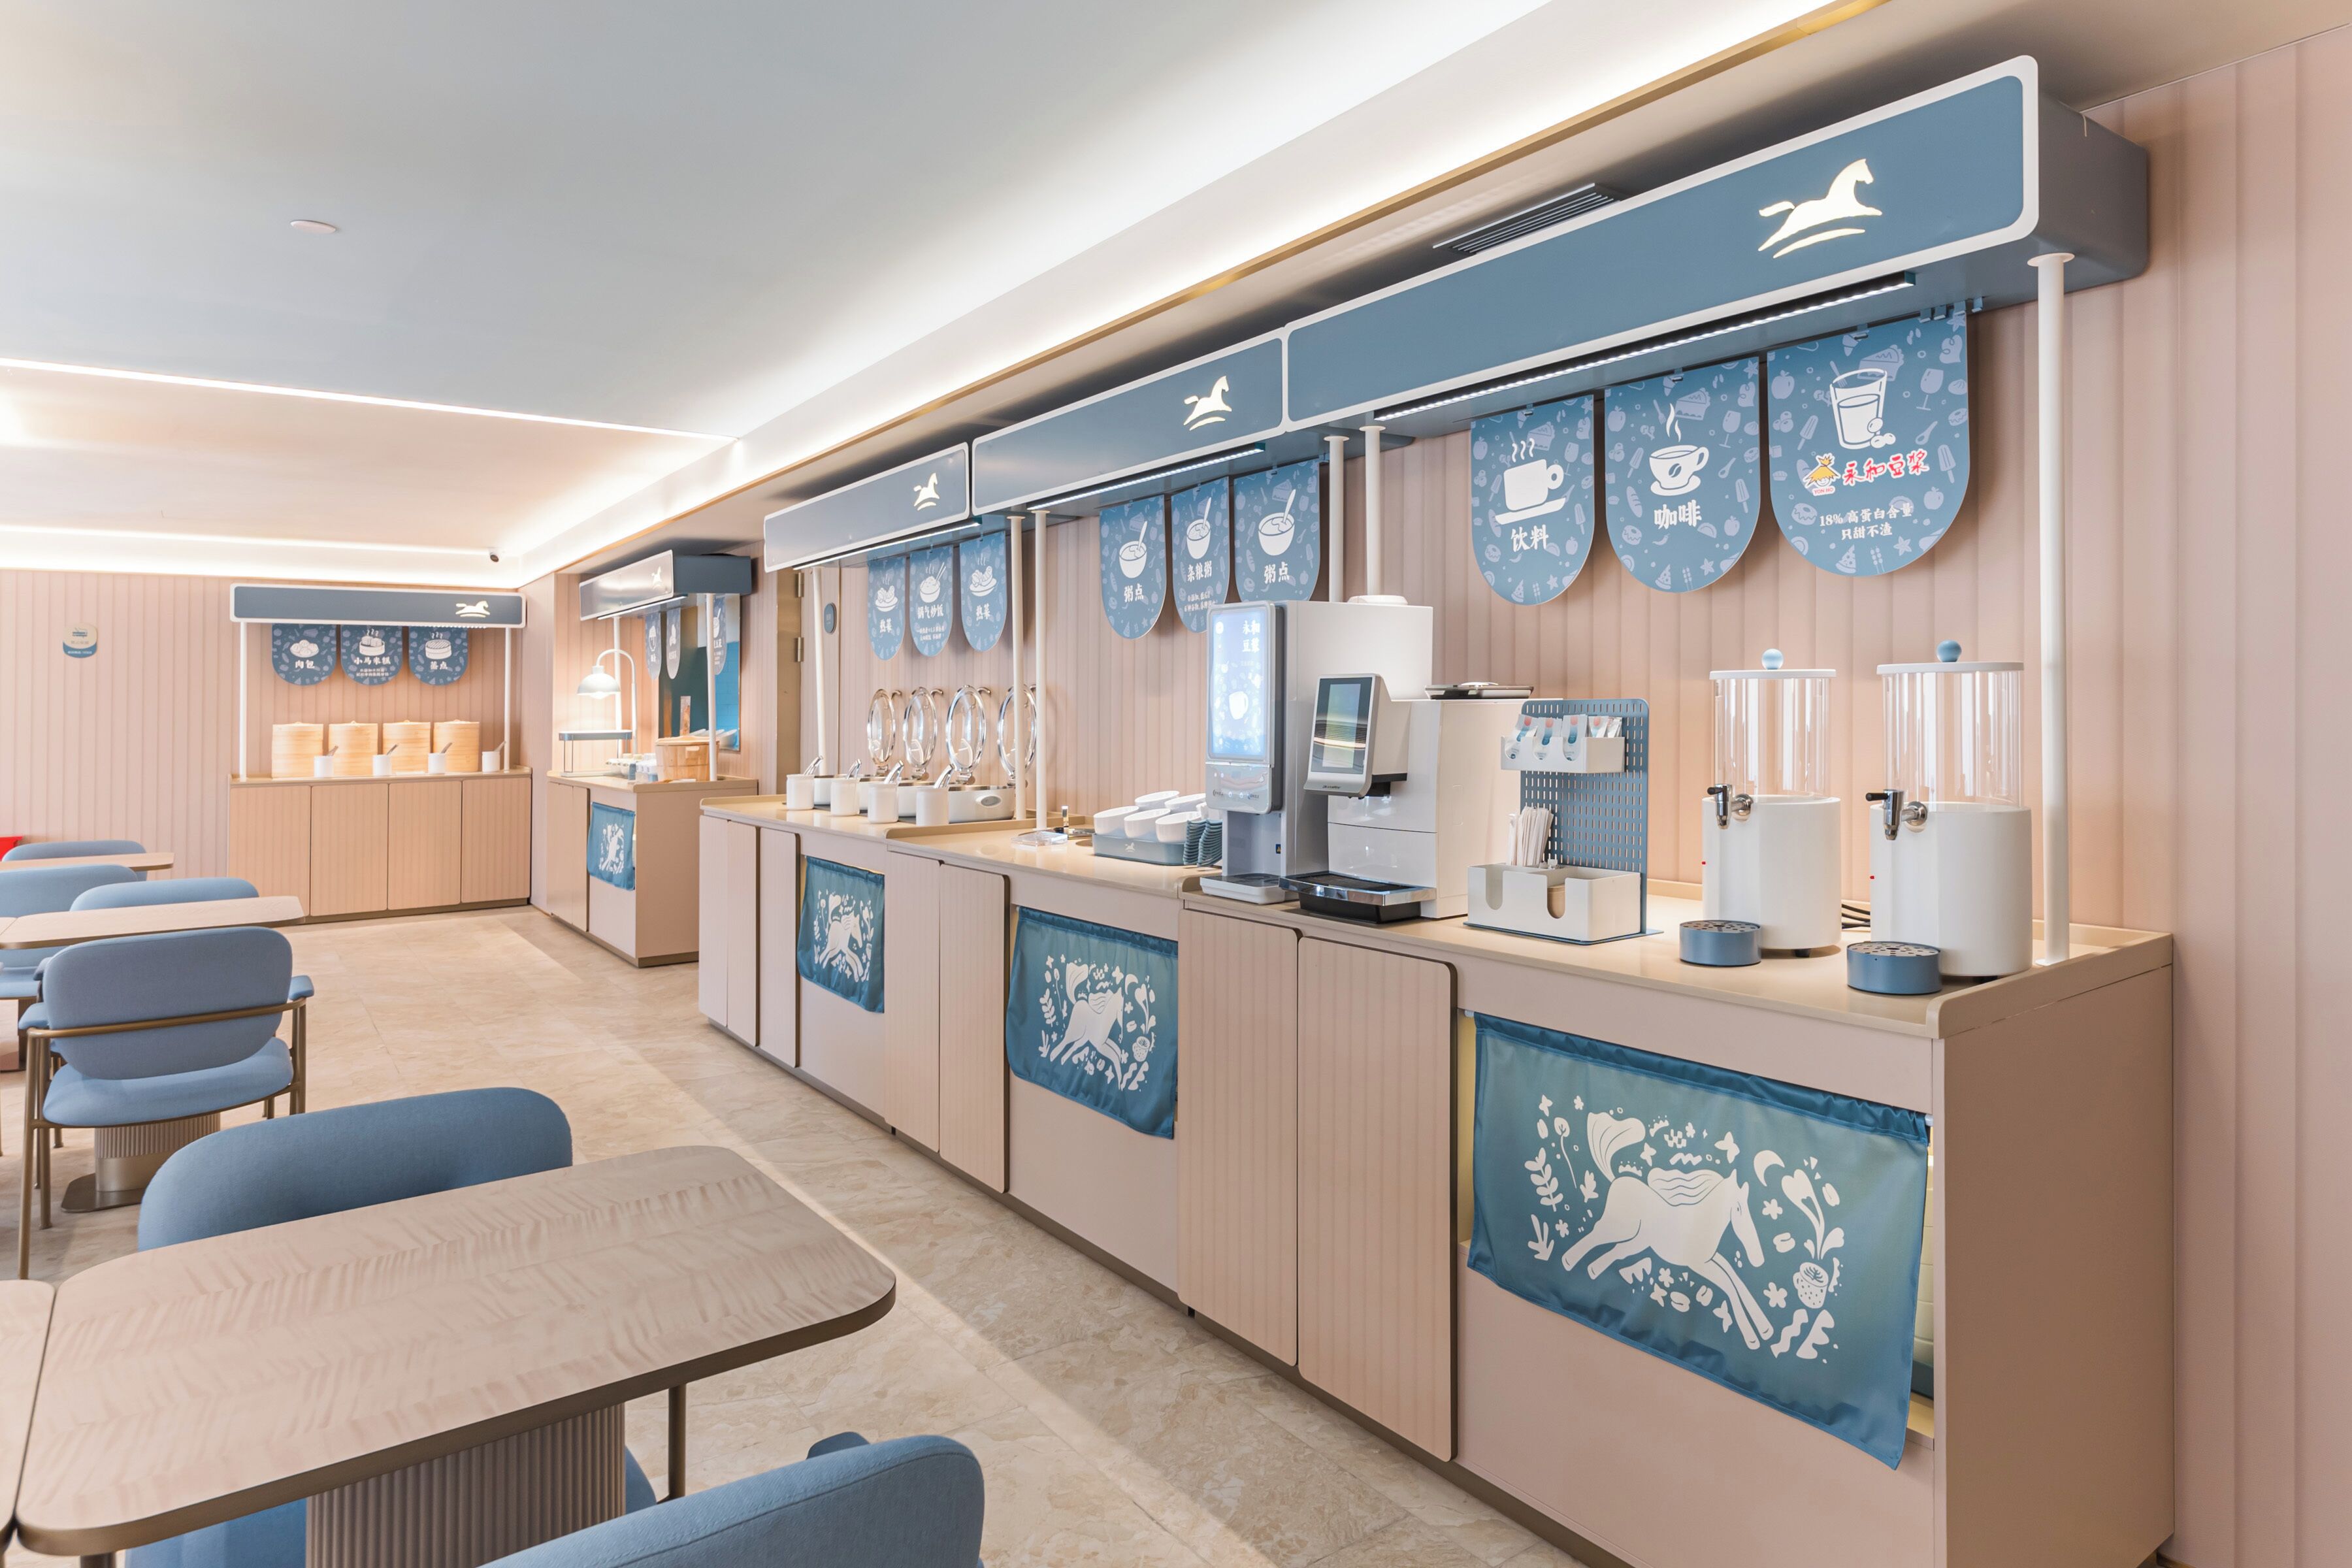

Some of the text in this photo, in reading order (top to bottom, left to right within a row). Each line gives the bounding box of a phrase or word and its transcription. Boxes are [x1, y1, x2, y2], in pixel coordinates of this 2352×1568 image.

[1654, 499, 1702, 529] 咖啡
[1820, 502, 1913, 527] 18% 高蛋白含量
[1511, 524, 1549, 552] 饮料
[1841, 522, 1893, 540] 只甜不渣
[1187, 560, 1212, 583] 杂粮粥
[1264, 561, 1290, 584] 粥点
[1124, 583, 1144, 602] 粥点
